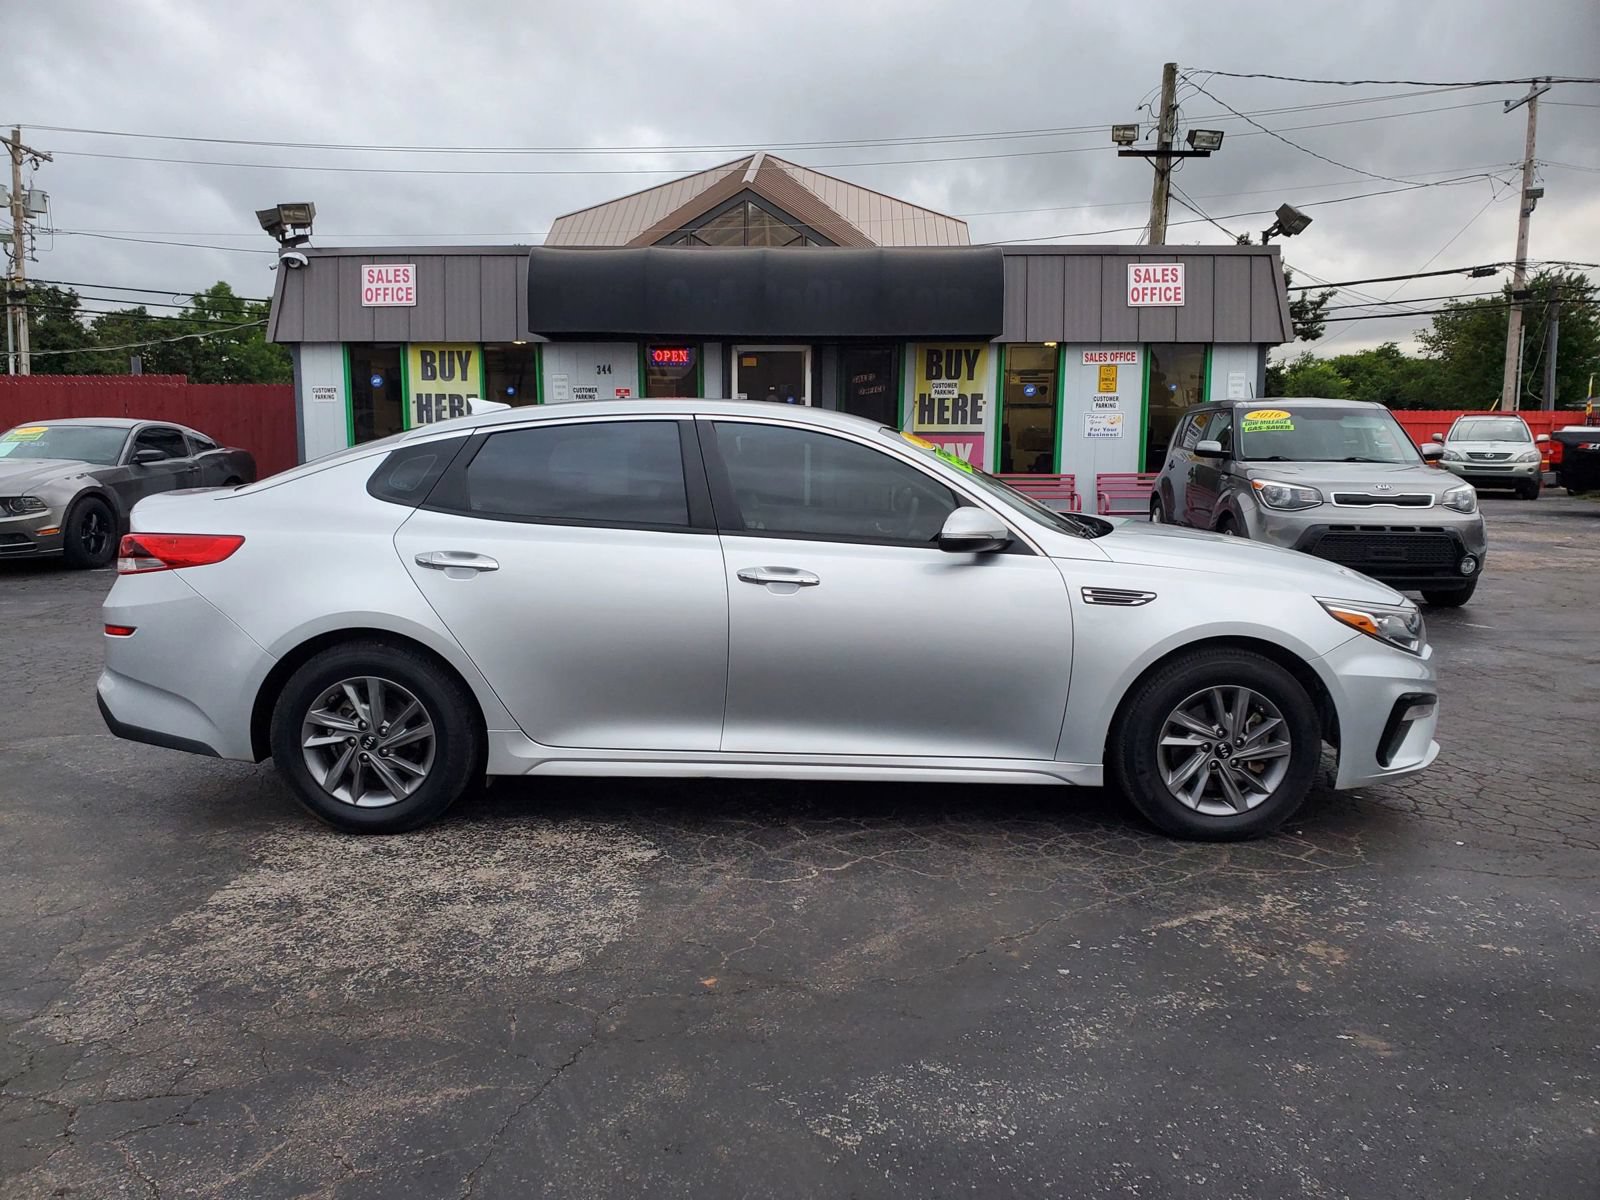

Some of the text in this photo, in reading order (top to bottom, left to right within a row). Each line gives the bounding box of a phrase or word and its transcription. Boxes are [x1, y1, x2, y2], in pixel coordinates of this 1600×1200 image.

[367, 268, 410, 283] SALES
[1134, 268, 1178, 283] SALES
[365, 286, 413, 302] OFFICE
[1131, 286, 1182, 302] OFFICE
[654, 350, 687, 362] OPEN
[1084, 351, 1136, 363] SALES OFFICE
[420, 350, 472, 381] BUY
[597, 364, 612, 375] 344
[925, 348, 980, 381] BUY
[917, 393, 984, 425] HERE
[1252, 411, 1282, 420] 2016
